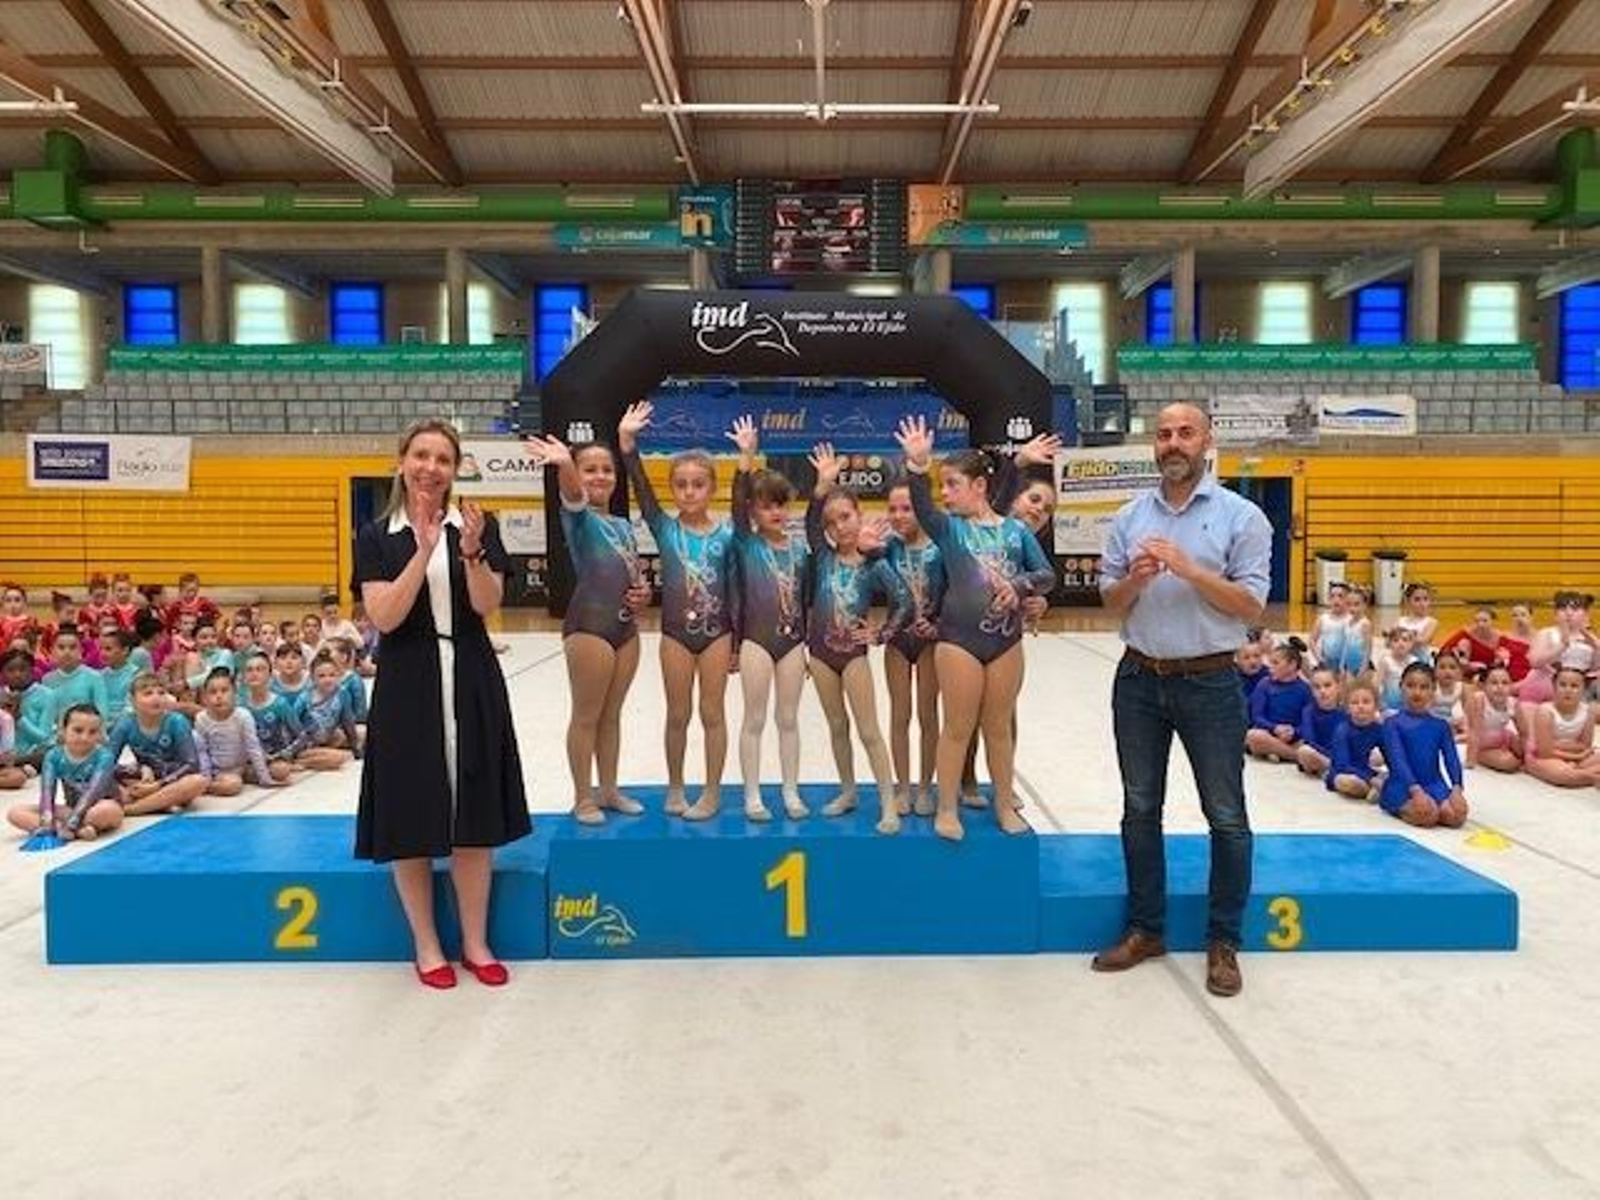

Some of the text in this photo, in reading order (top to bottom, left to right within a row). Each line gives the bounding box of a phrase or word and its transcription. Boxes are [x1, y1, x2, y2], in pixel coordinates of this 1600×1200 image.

[596, 229, 651, 243] cajamar
[1003, 228, 1060, 242] cajamar
[691, 301, 748, 327] imd
[834, 311, 888, 323] Municipal
[893, 311, 907, 321] de
[798, 322, 845, 335] Deportes
[761, 408, 805, 430] imd
[839, 471, 882, 485] EJIDO
[554, 892, 598, 918] imd
[766, 851, 807, 937] 1
[275, 886, 318, 949] 2
[1267, 896, 1302, 949] 3
